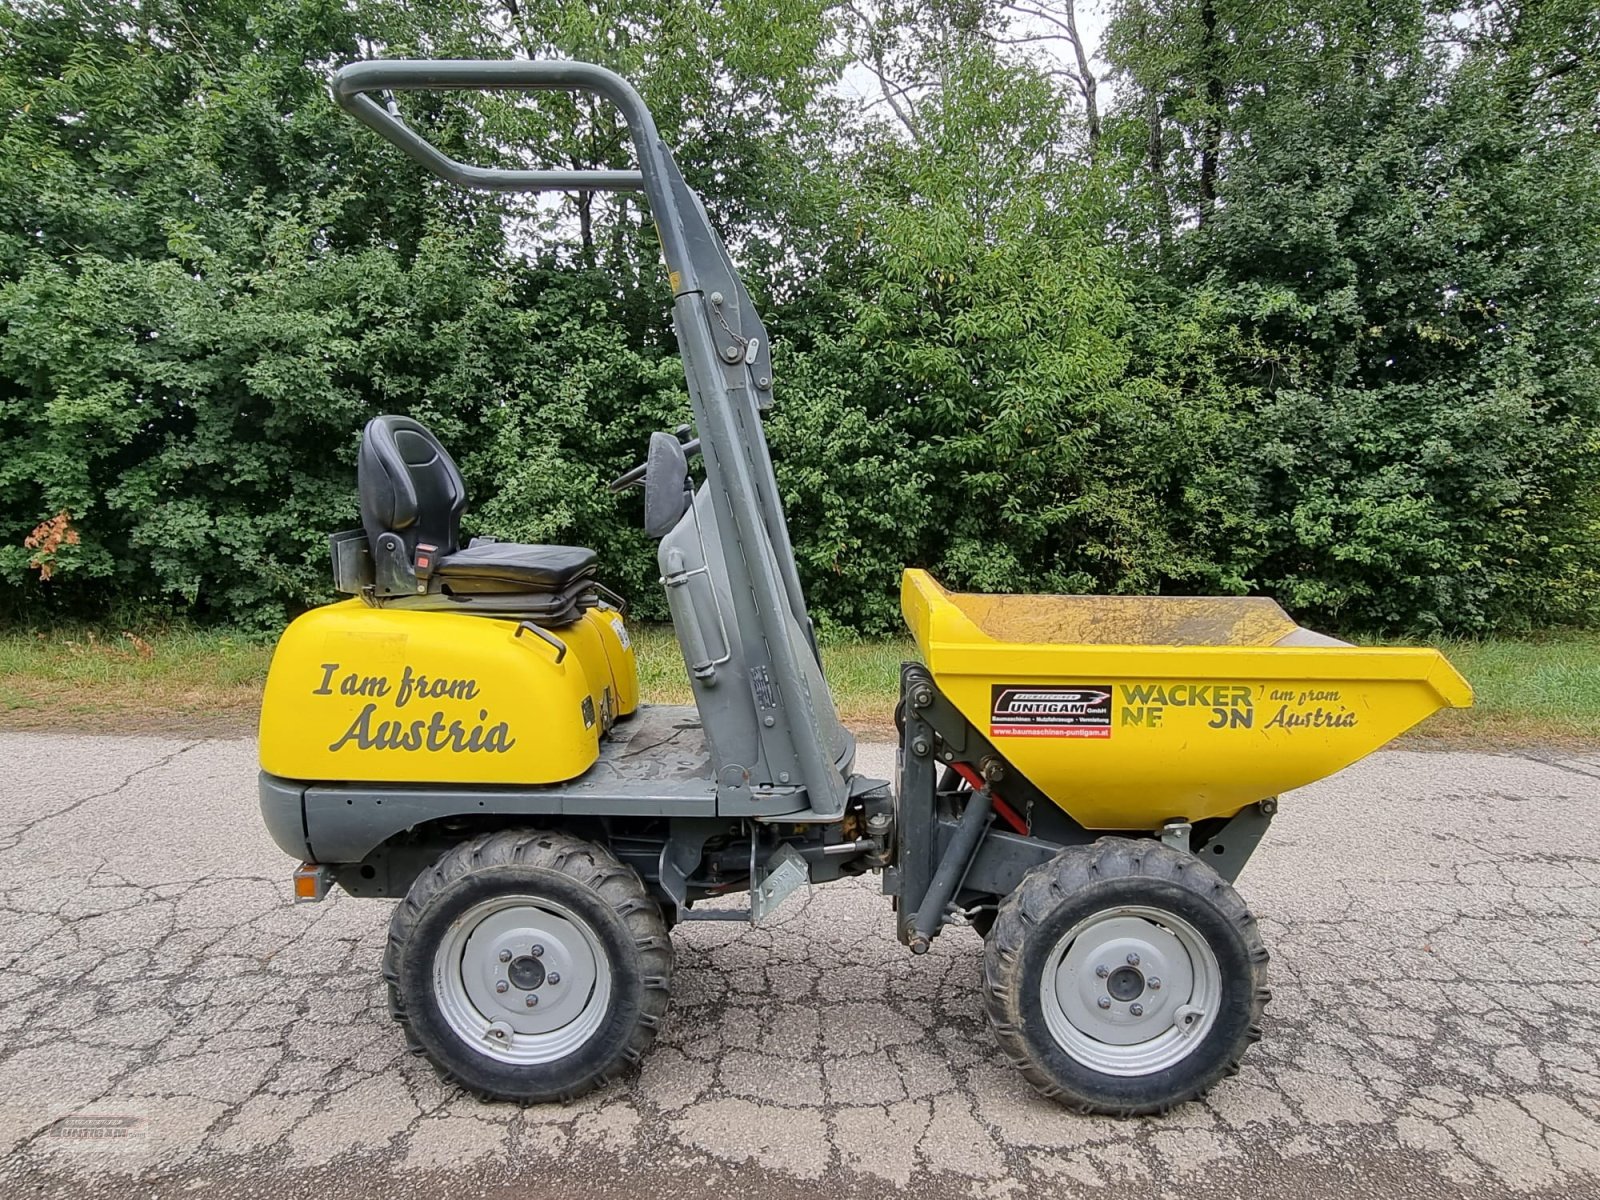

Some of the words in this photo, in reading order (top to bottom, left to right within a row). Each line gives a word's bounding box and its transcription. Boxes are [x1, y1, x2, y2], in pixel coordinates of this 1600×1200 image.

[312, 663, 340, 696] I
[340, 672, 392, 698] am
[395, 665, 480, 708] from
[1119, 684, 1253, 707] WACKER
[1270, 689, 1296, 702] am
[328, 703, 516, 754] Austria
[1263, 704, 1359, 730] Austria
[993, 728, 1109, 738] www.baumaschinen-puntigam.at
